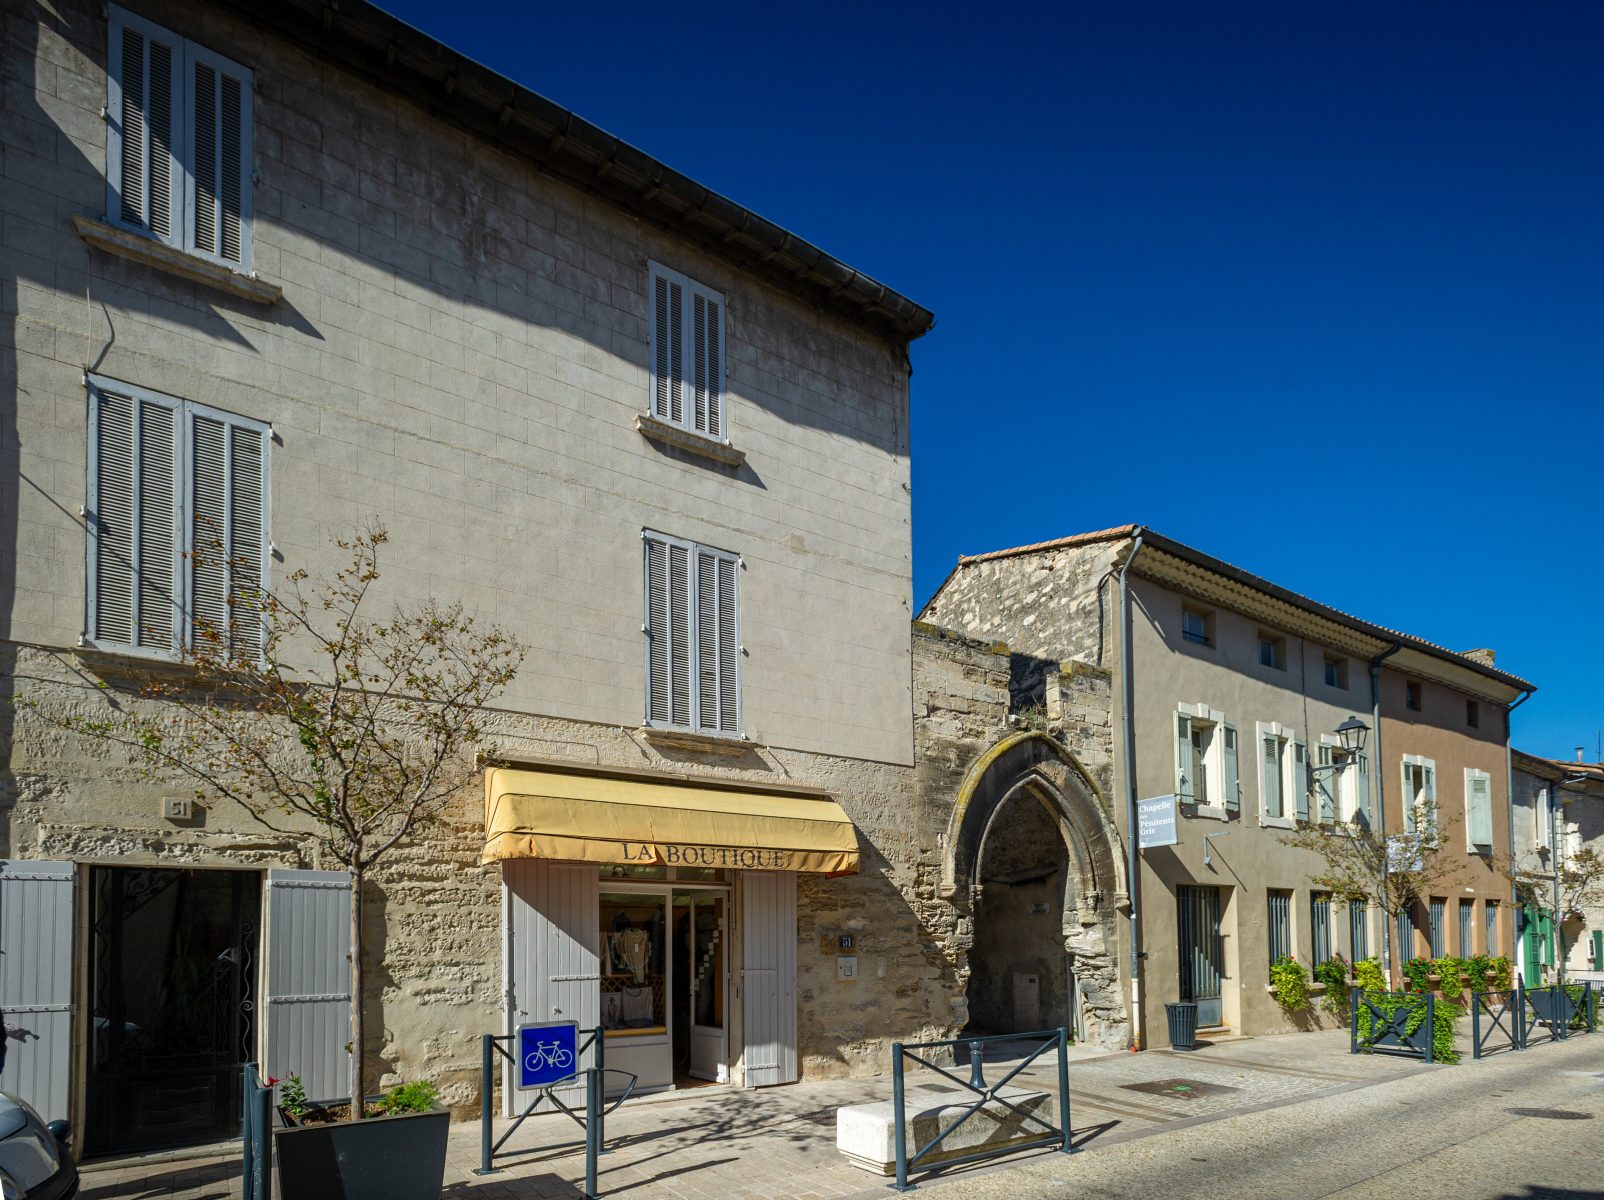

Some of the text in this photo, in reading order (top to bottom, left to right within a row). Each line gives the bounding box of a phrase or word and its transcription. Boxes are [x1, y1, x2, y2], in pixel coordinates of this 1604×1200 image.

[171, 801, 187, 817] 51
[1139, 801, 1172, 812] Chapelle
[1140, 817, 1176, 828] Pénitents
[1140, 827, 1156, 836] Gris
[621, 842, 785, 869] LA BOUTIQUE
